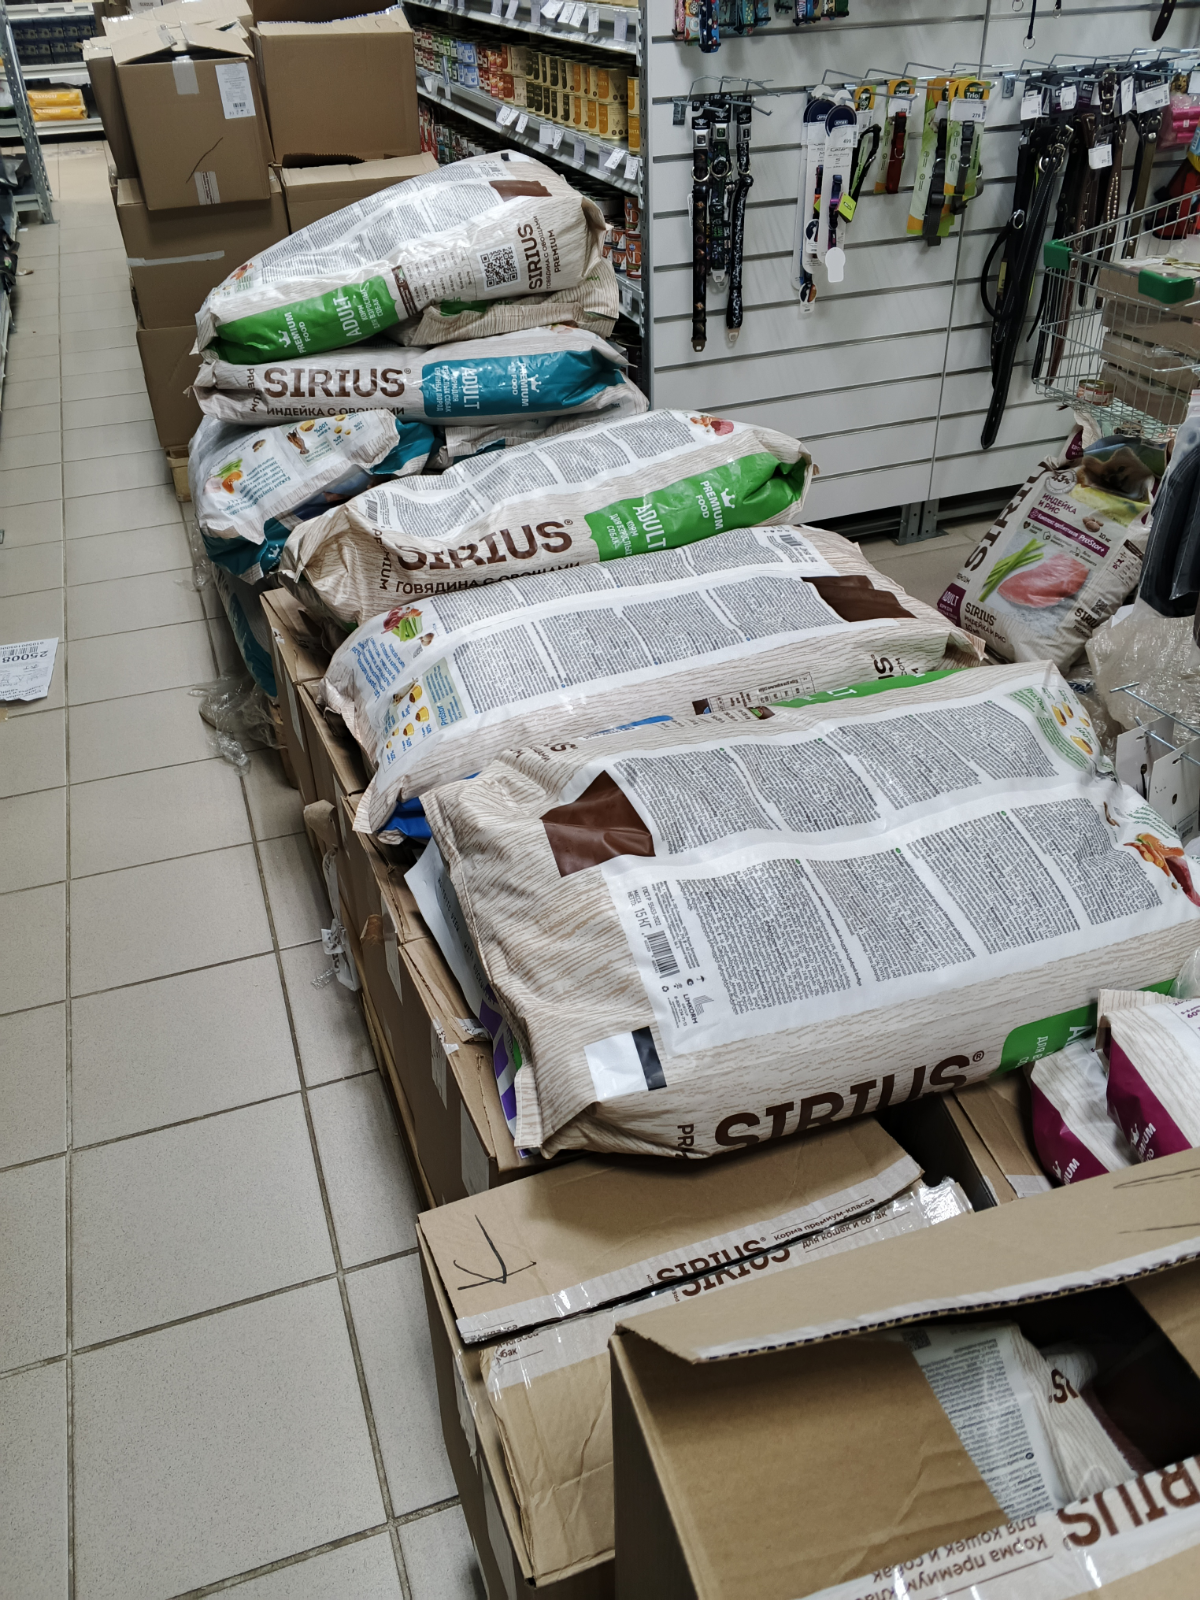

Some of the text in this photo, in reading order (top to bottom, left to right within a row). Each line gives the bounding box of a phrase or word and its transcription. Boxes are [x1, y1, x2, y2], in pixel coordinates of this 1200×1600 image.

[518, 223, 542, 289] SIRIUS
[547, 229, 561, 273] PREMIUM
[284, 311, 307, 354] PREMIUM
[298, 321, 312, 343] FOOD
[461, 366, 480, 410] ADULT
[510, 374, 519, 396] FOOD
[266, 405, 324, 417] ИНДЕЙКА
[327, 407, 336, 417] С
[695, 494, 710, 519] FOOD
[699, 480, 724, 531] PREMIUM
[1042, 493, 1078, 515] ИНДЕЙКА
[1043, 502, 1061, 515] РИС
[632, 503, 667, 549] ADULT
[396, 579, 480, 595] ГОВЯДИНА
[963, 601, 998, 627] SIRIUS
[2, 650, 49, 664] 25008
[632, 889, 643, 904] МАССА
[633, 907, 648, 920] 15
[637, 915, 653, 932] КГ
[682, 993, 699, 1025] LIMKORM
[714, 1054, 971, 1148] SIRIUS
[773, 1197, 876, 1242] Корма премиум-класса
[802, 1209, 889, 1250] для кошек и соак
[993, 1532, 1048, 1564] Корма
